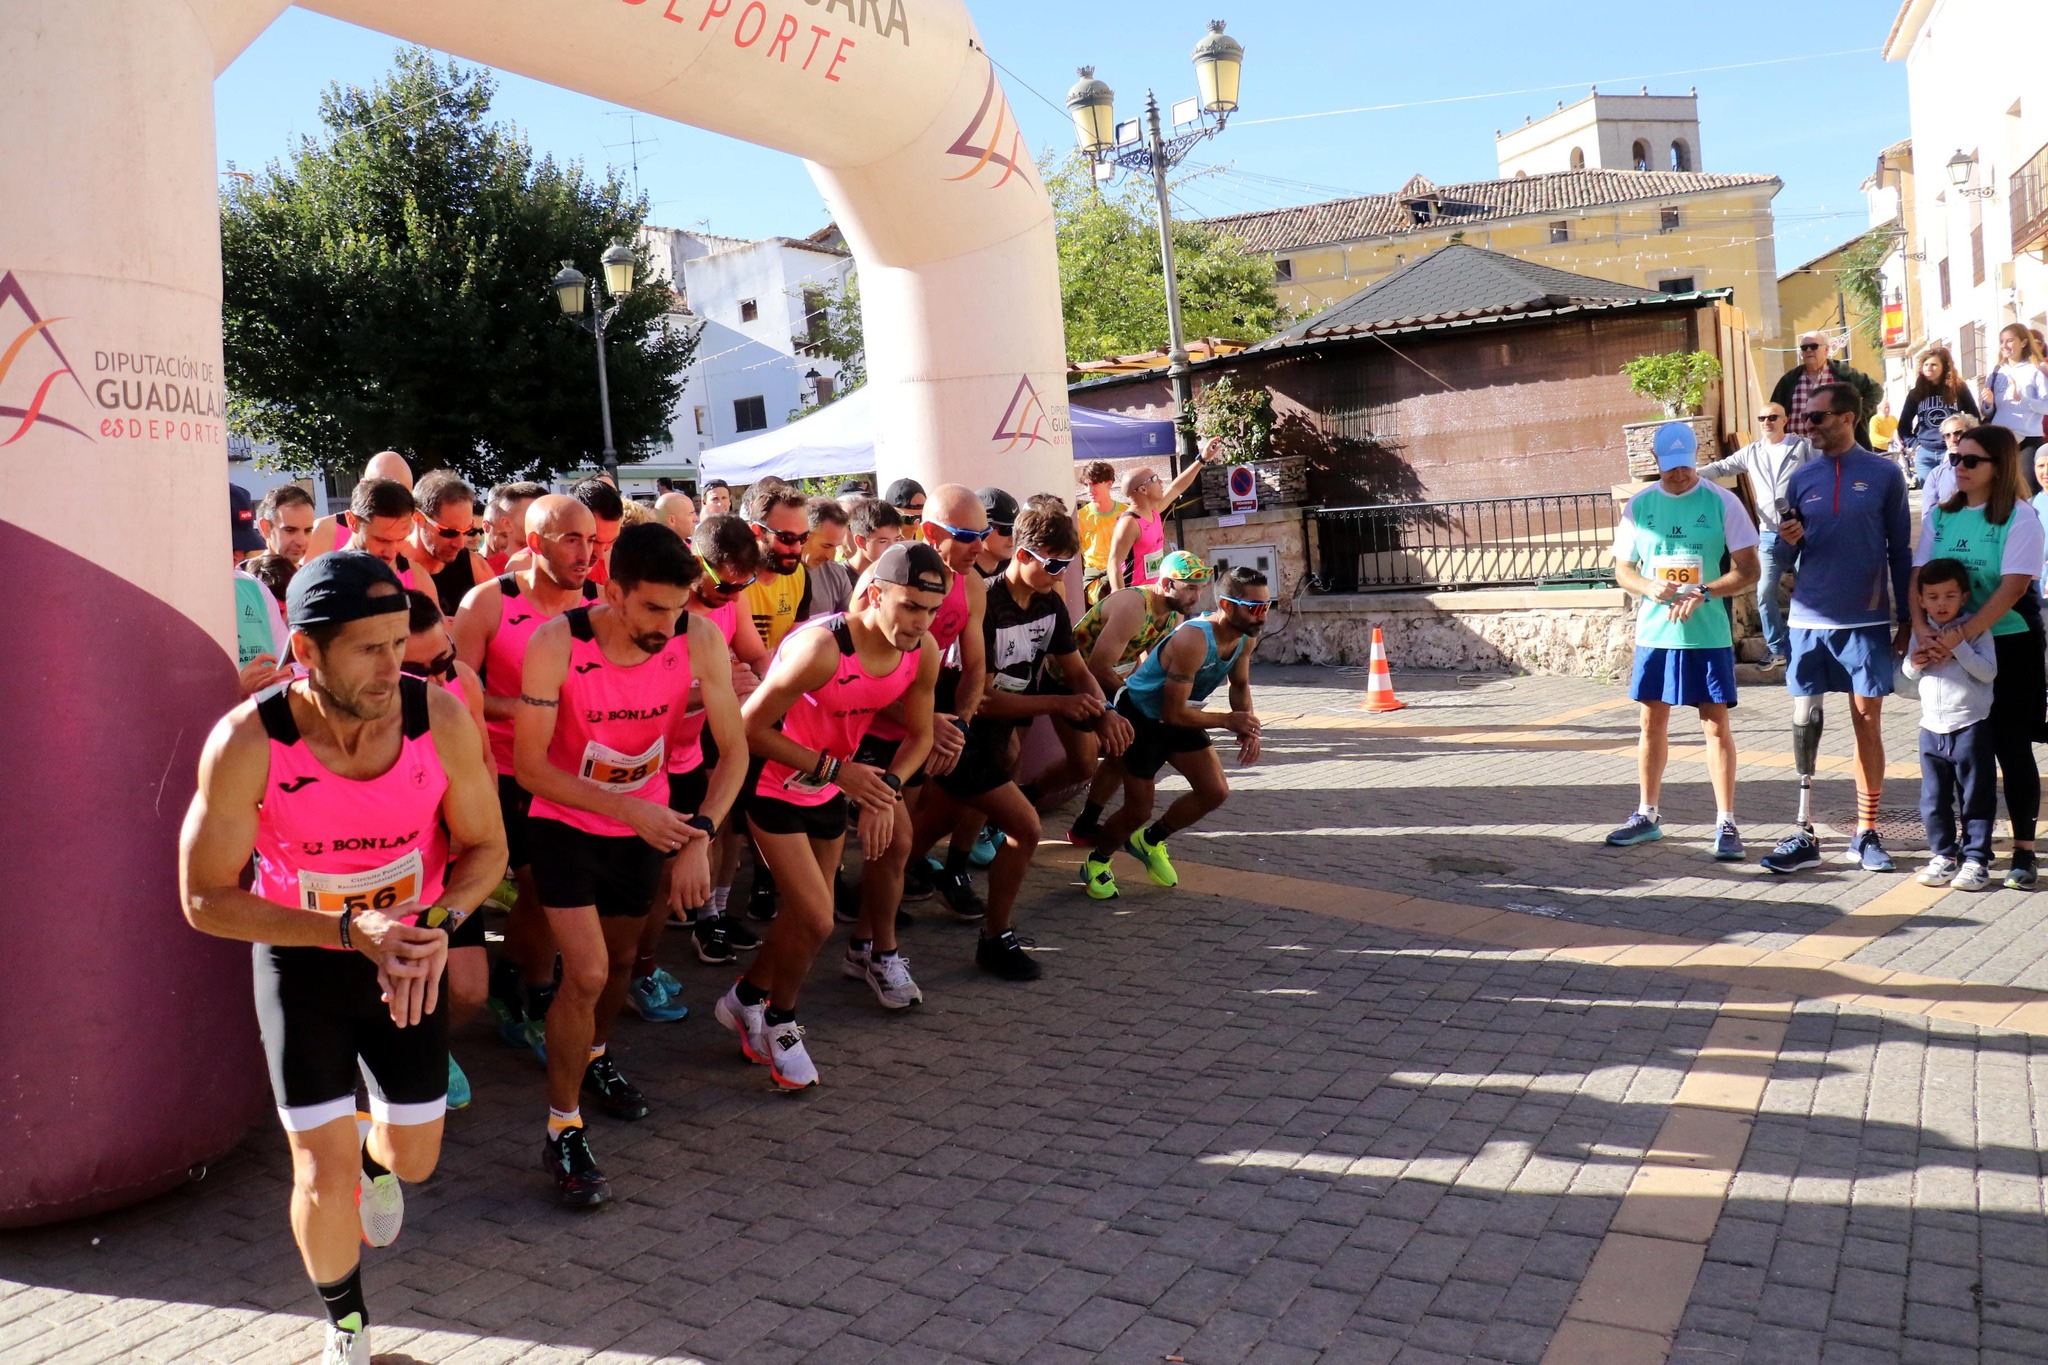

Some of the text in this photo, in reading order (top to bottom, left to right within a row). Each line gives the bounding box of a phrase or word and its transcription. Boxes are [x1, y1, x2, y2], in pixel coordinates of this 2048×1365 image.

[803, 0, 910, 47] ARA
[622, 0, 856, 83] PORTE
[95, 351, 214, 383] DIPUTACIÓN DE
[1672, 526, 1682, 534] IX
[1957, 539, 1968, 548] IX
[1666, 569, 1689, 582] 66
[608, 764, 649, 784] 28
[344, 886, 397, 912] 56
